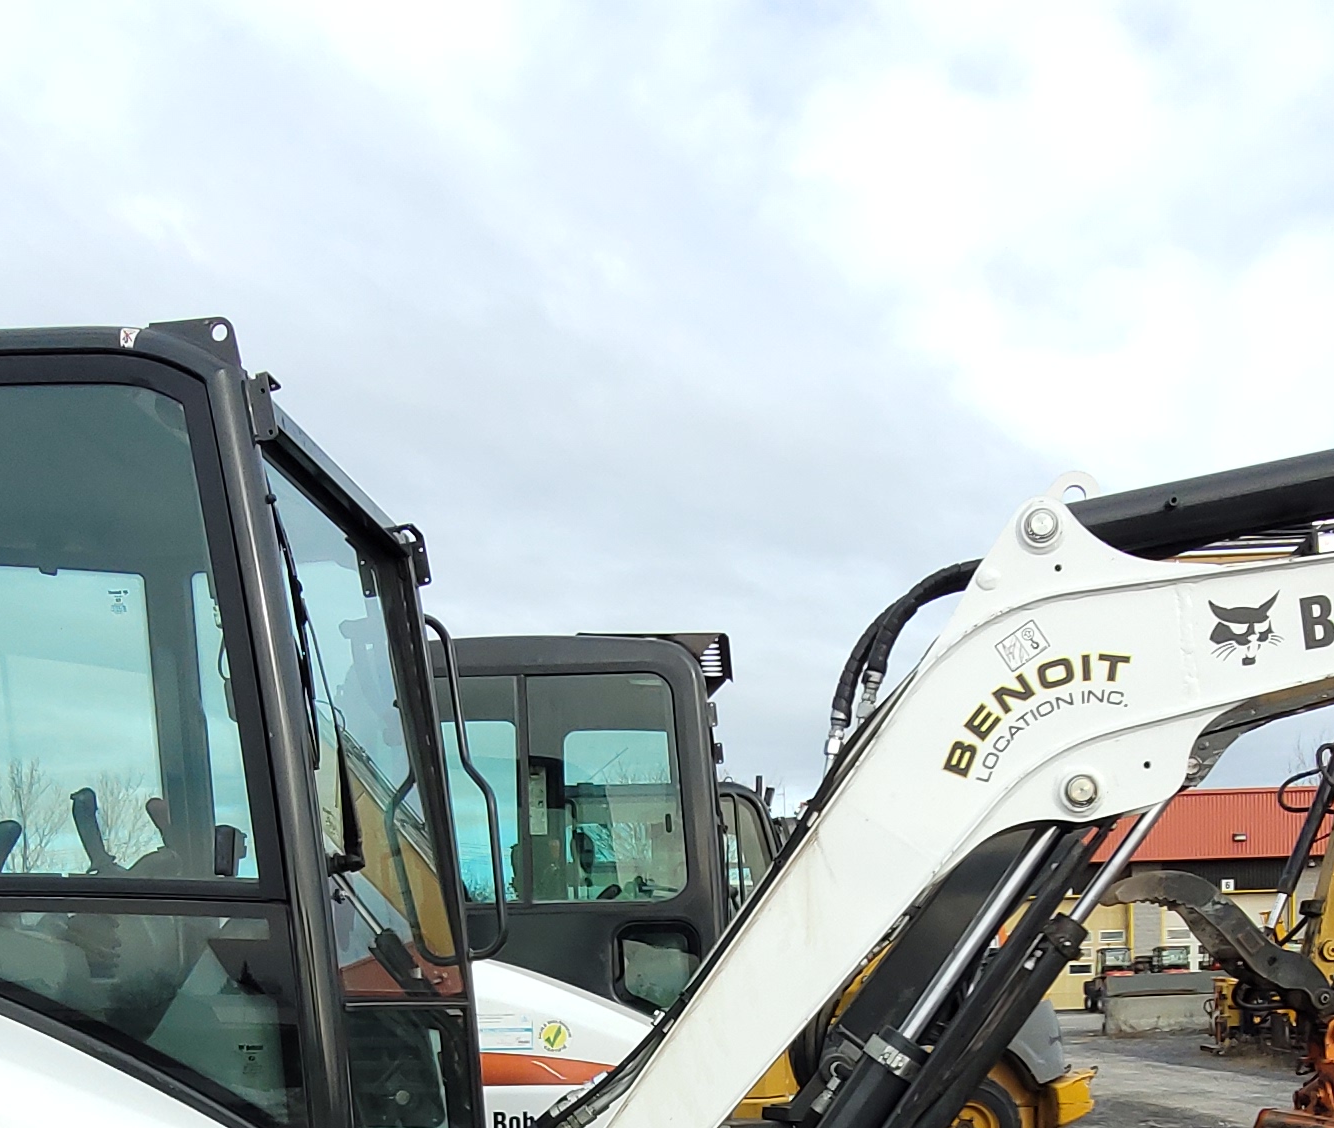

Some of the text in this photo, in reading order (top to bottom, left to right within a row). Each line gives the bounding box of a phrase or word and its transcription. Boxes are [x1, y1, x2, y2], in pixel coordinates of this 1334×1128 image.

[942, 652, 1132, 778] BENOIT
[975, 689, 1129, 783] LOCATION INC.
